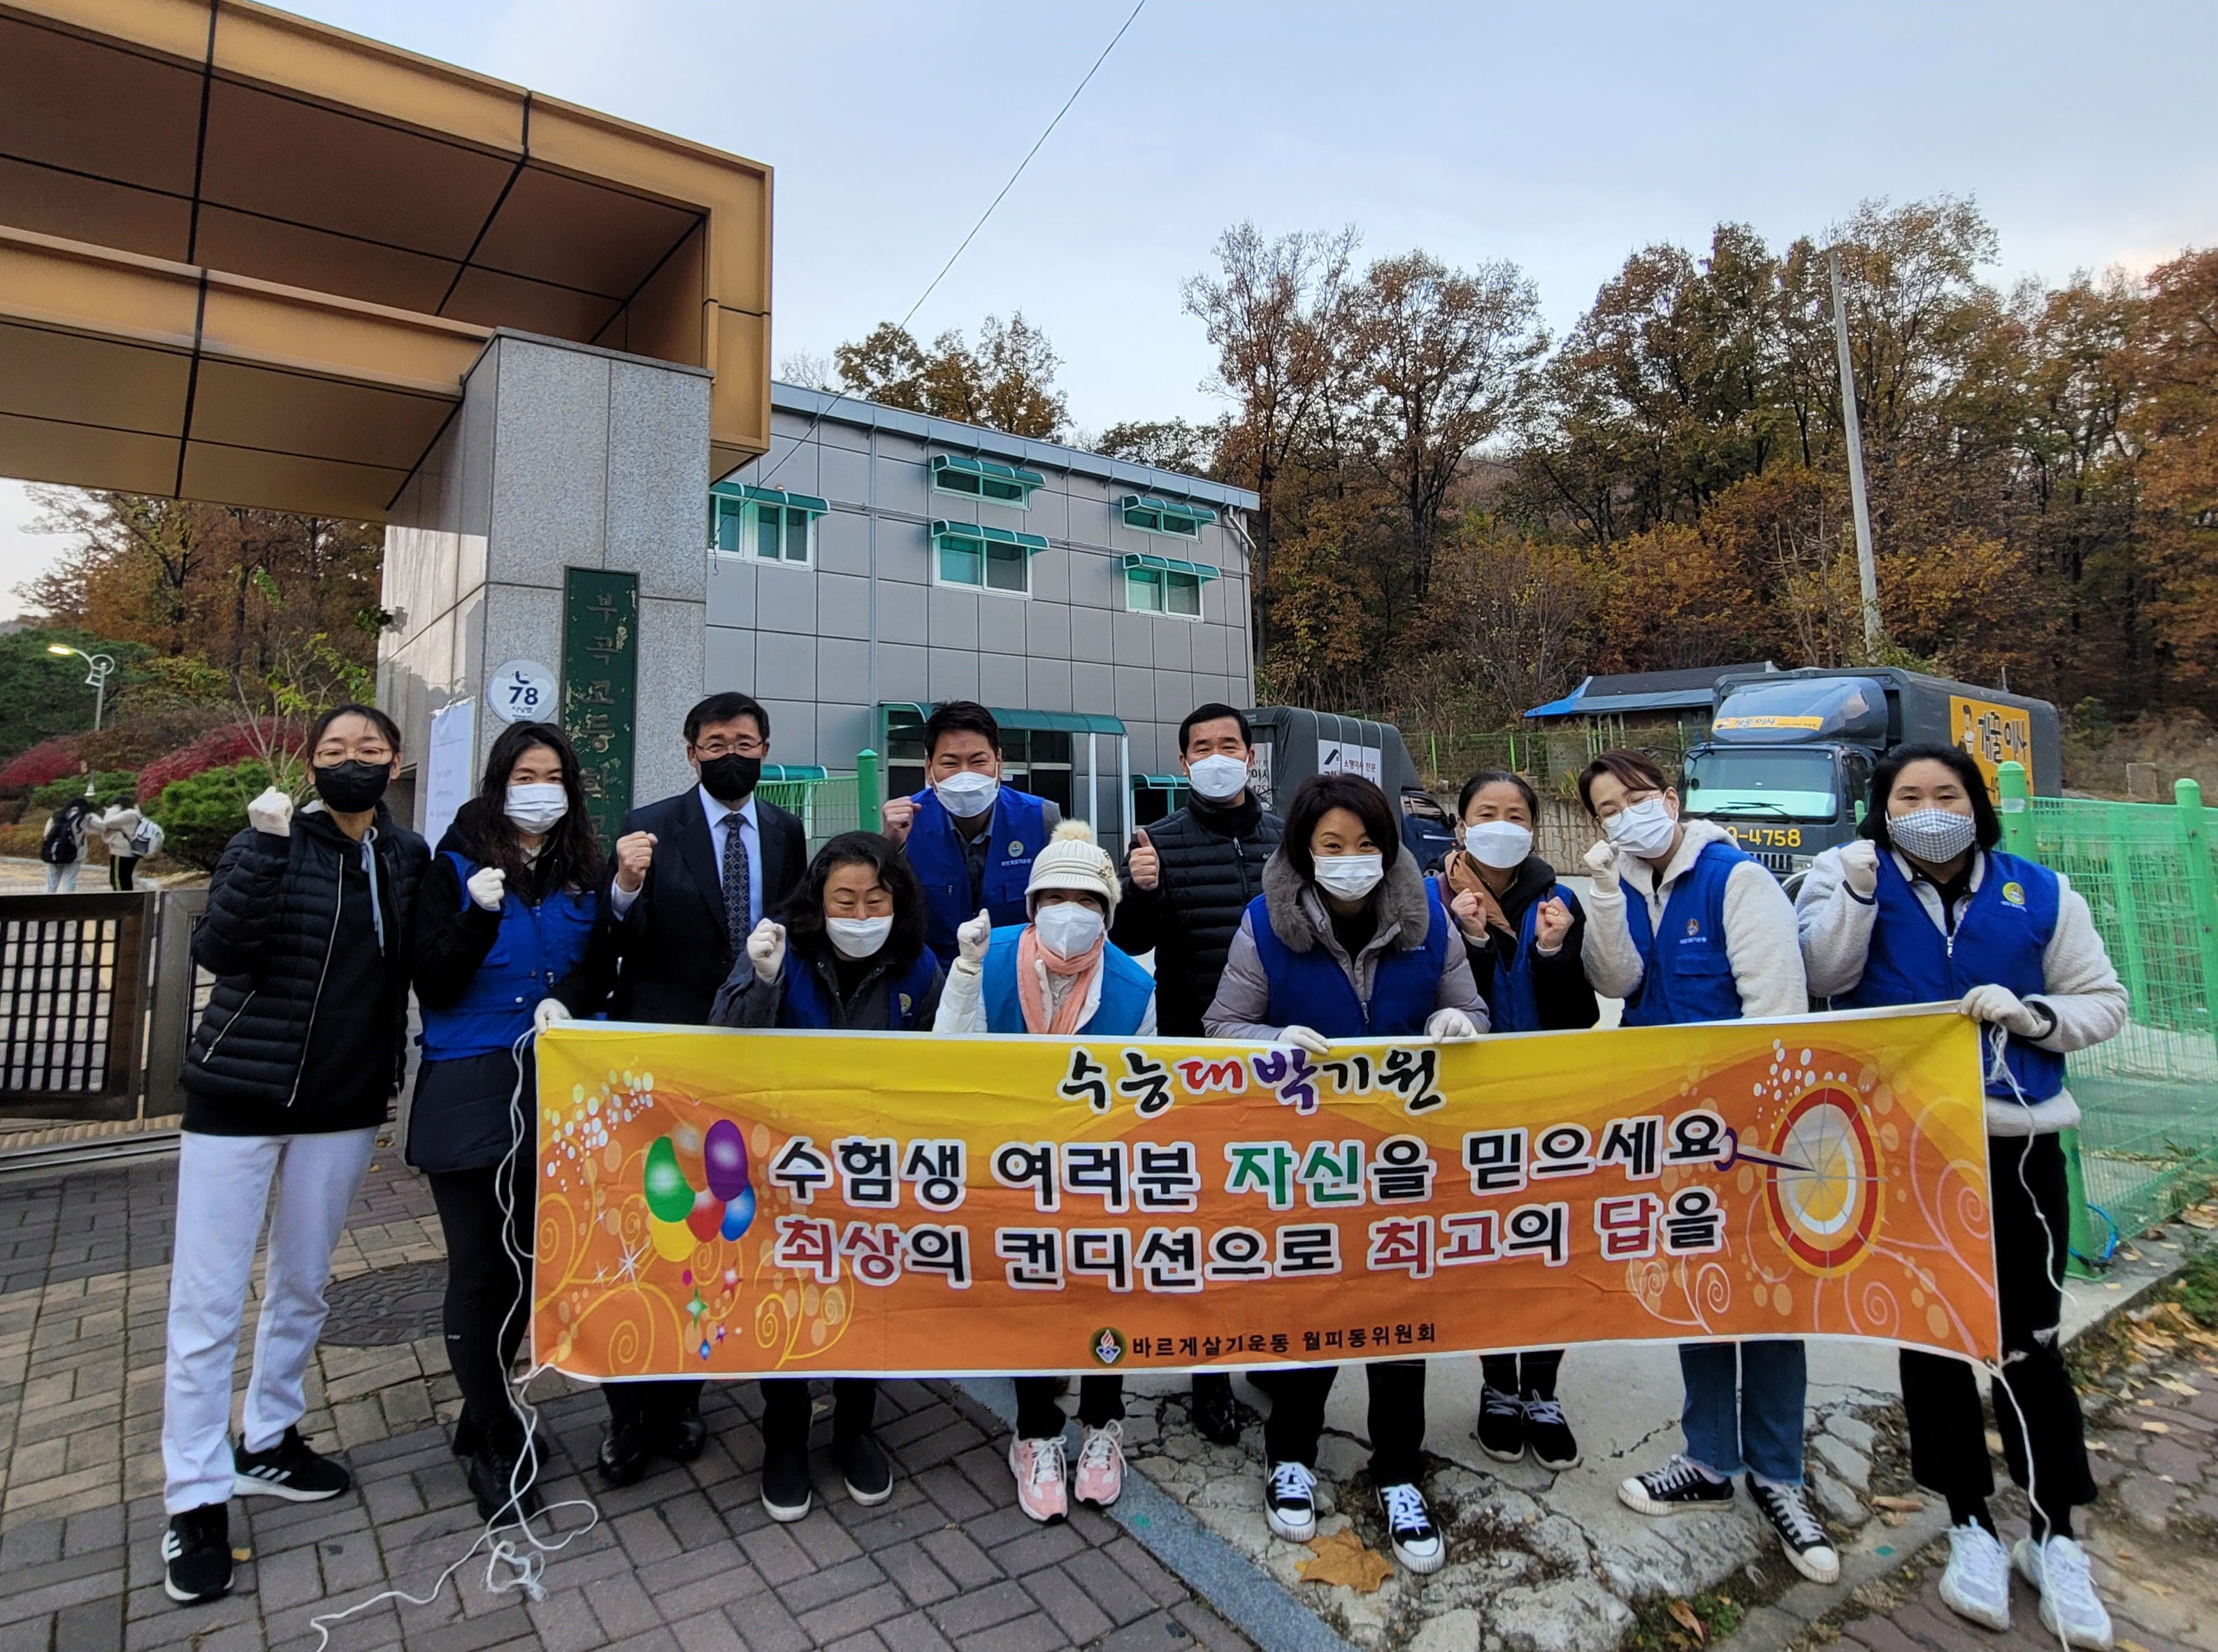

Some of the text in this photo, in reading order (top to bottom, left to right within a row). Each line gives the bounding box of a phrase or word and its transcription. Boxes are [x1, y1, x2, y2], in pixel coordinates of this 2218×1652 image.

[508, 686, 538, 706] 78
[1061, 1047, 1442, 1116] 수능대박기원
[774, 1114, 1725, 1208] 수험생 여러분 자신을 믿으세요
[779, 1190, 1723, 1288] 최상의 컨디션으로 최고의 답을
[1132, 1322, 1436, 1359] 바르게살기운동 월피동위원회
